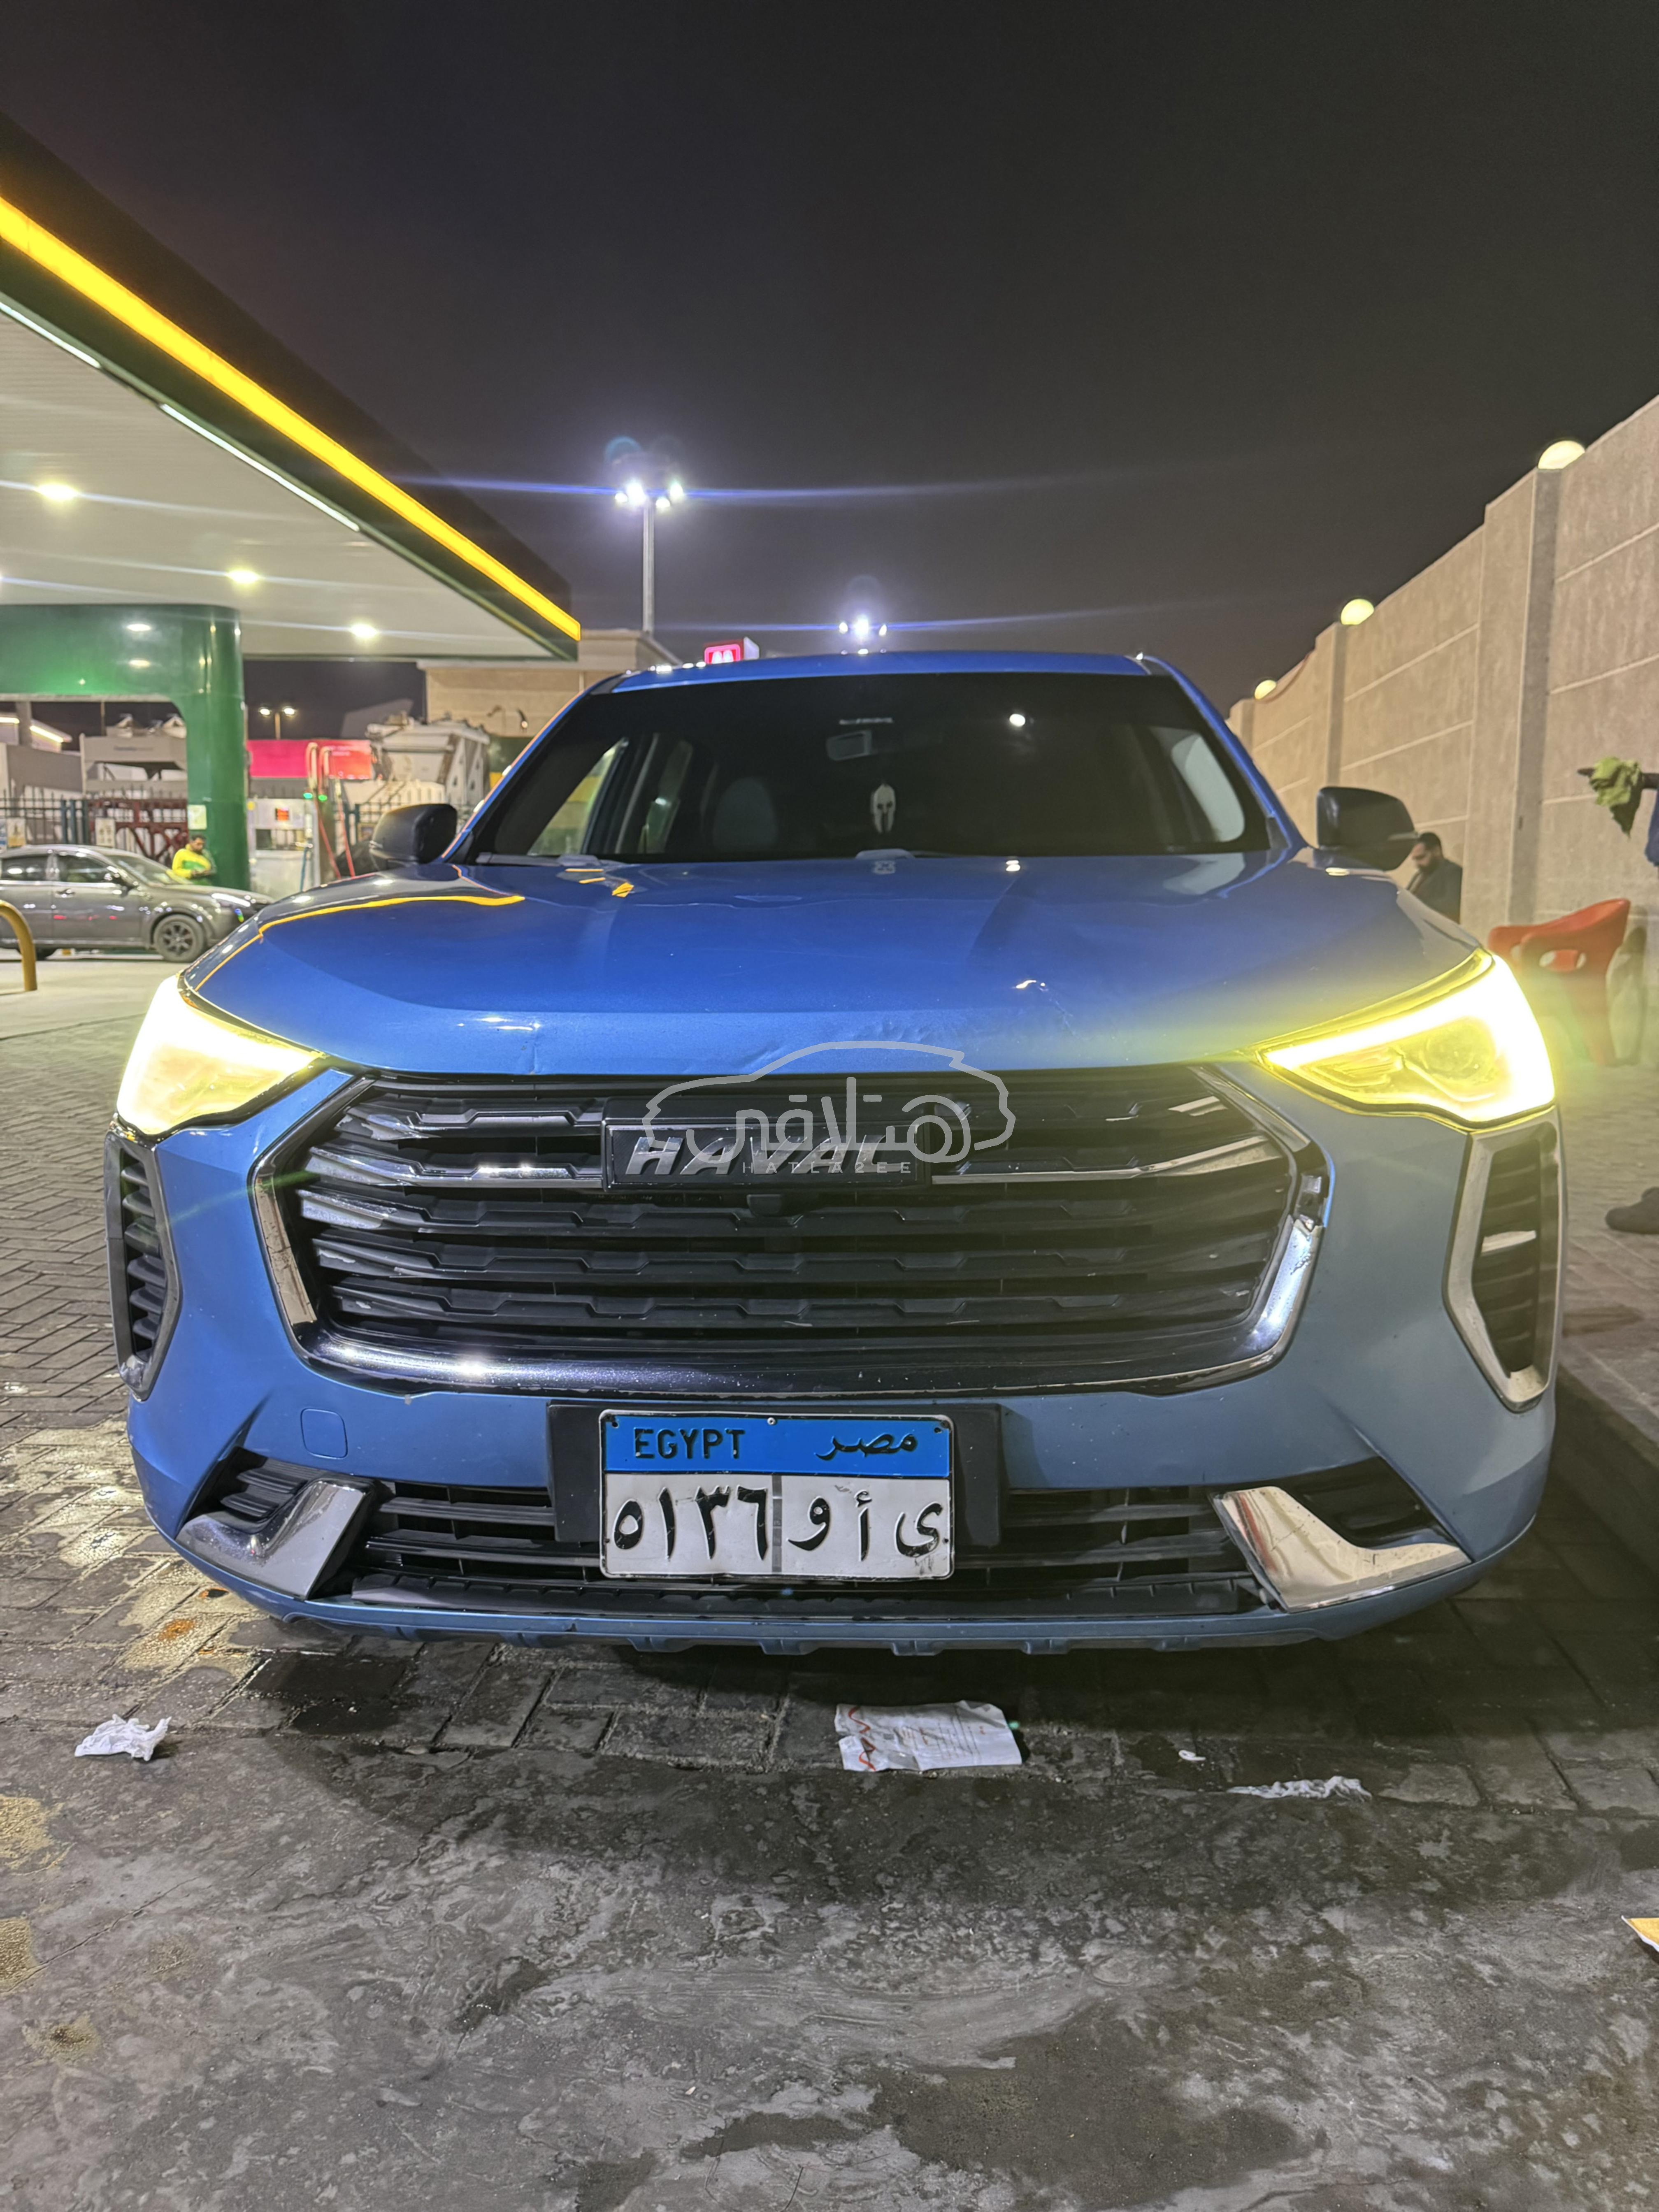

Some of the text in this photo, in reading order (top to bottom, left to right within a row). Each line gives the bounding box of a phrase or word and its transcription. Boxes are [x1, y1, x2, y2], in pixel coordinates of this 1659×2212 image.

[625, 1135, 911, 1175] HAVAL
[634, 1427, 746, 1460] EGYPT
[815, 1432, 919, 1461] مصر
[612, 1485, 768, 1561] ٥١٣٦
